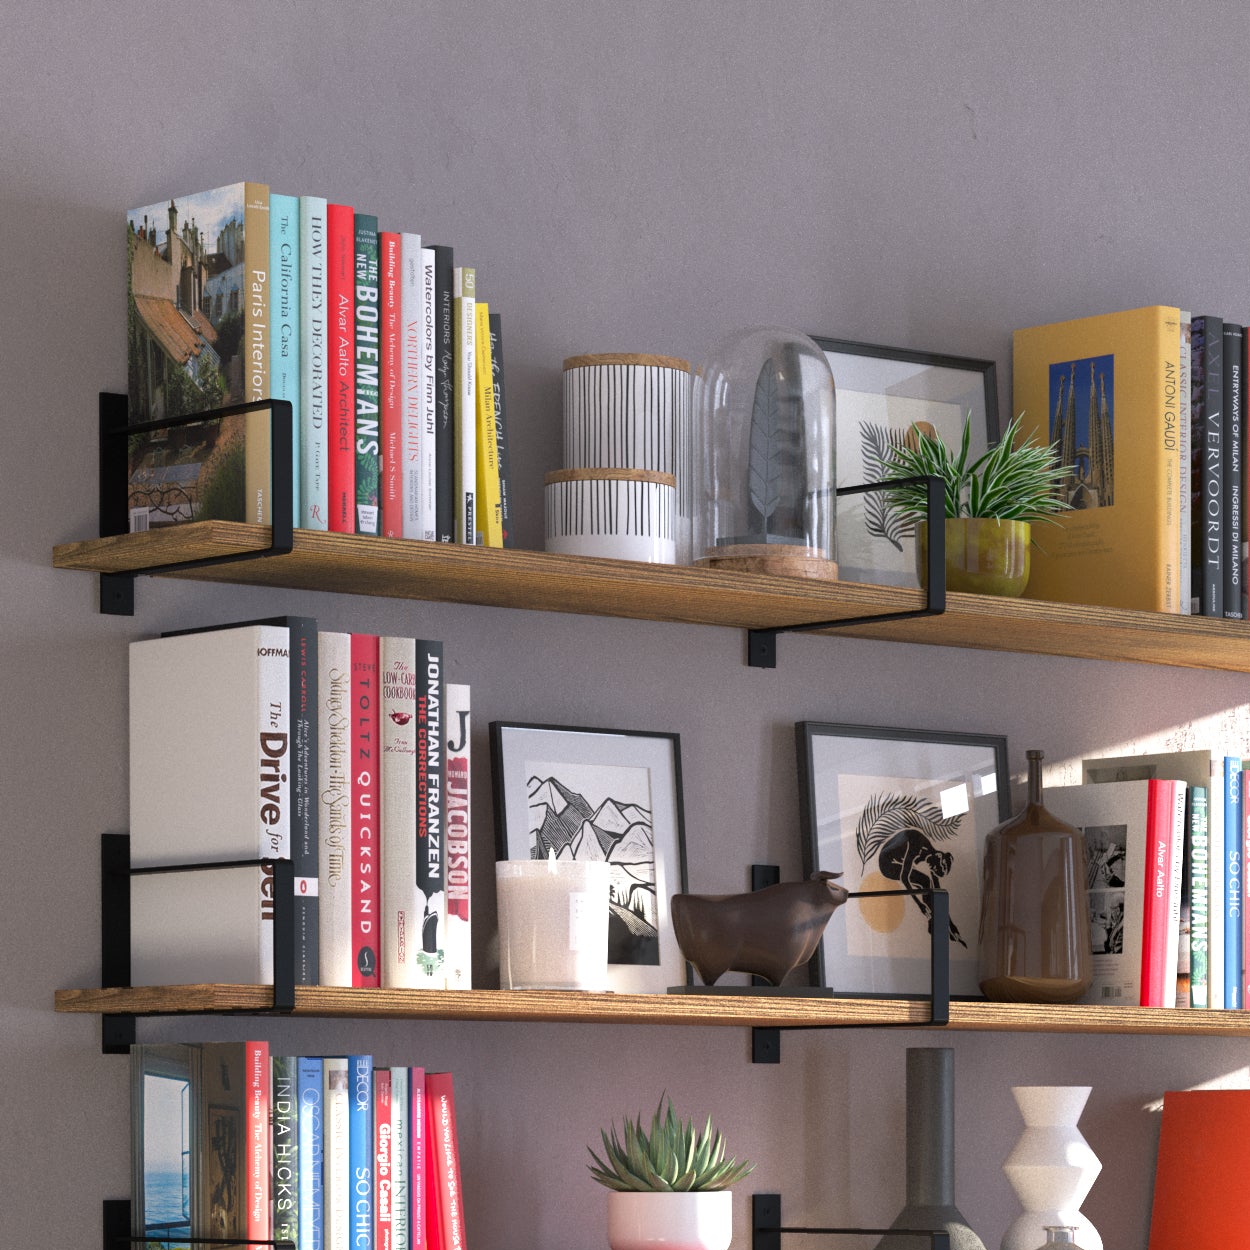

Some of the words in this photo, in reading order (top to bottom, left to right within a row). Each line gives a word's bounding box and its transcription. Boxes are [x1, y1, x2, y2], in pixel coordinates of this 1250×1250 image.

[280, 215, 289, 235] The
[311, 216, 322, 259] HOW
[356, 253, 367, 281] NEW
[368, 259, 378, 281] THE
[387, 241, 396, 278] Building
[251, 269, 267, 318] Paris
[280, 243, 293, 318] California
[311, 262, 322, 314] THEY
[387, 280, 396, 308] Beauty
[465, 273, 474, 289] 50
[338, 293, 350, 332] Alvar
[388, 313, 396, 329] The
[424, 264, 433, 351] Watercolors
[443, 290, 451, 345] INTERIORS
[280, 323, 292, 358] Casa
[338, 336, 350, 376] Aalto
[387, 333, 396, 367] Alchemy
[406, 319, 418, 392] NORTHERN
[311, 318, 323, 430] DECORATED
[356, 284, 379, 456] BOHEMIANS
[388, 369, 396, 378] of
[424, 354, 434, 371] by
[1208, 332, 1220, 399] AXEL
[387, 380, 396, 409] Design
[426, 375, 434, 404] Finn
[483, 386, 493, 412] Milan
[1164, 361, 1176, 408] ANTONI
[338, 380, 350, 452] Architect
[406, 396, 419, 462] DELIGHTS
[426, 406, 434, 434] Juhl
[1164, 411, 1179, 452] GAUDÍ
[1232, 424, 1239, 438] OF
[388, 432, 397, 464] Michael
[485, 413, 495, 470] Architecture
[256, 488, 264, 523] TASCHEN
[389, 475, 397, 500] Smith
[1207, 411, 1220, 570] VERVOORDT
[1232, 532, 1239, 542] DI
[257, 647, 289, 658] OFFMA
[353, 662, 377, 673] STEVE
[394, 661, 409, 671] The
[326, 668, 350, 713] Sidney
[270, 701, 282, 728] The
[359, 678, 371, 760] TOLTZ
[418, 694, 427, 724] THE
[427, 653, 440, 767] JONATHAN
[328, 713, 350, 769] Sheldon
[447, 711, 470, 753] J
[259, 732, 288, 826] Drive
[303, 786, 309, 794] in
[418, 728, 427, 838] CORRECTIONS
[321, 789, 350, 834] Sands
[428, 773, 440, 879] FRANZEN
[1191, 813, 1200, 832] NEW
[265, 829, 283, 852] for
[325, 836, 343, 850] of
[357, 771, 371, 934] QUICKSAND
[447, 781, 468, 900] JACOBSON
[1157, 841, 1166, 867] Alvar
[328, 850, 344, 888] Time
[1229, 850, 1240, 875] SO
[1156, 869, 1165, 898] Aalto
[1229, 877, 1240, 918] CHIC
[253, 1050, 262, 1088] Building
[252, 1090, 262, 1120] Beauty
[277, 1077, 291, 1136] INDIA
[302, 1087, 320, 1156] OSCAR
[440, 1095, 449, 1126] WOULD
[254, 1123, 262, 1141] The
[377, 1123, 391, 1176] Giorgio
[396, 1119, 404, 1177] mexican
[252, 1143, 262, 1179] Alchemy
[277, 1144, 292, 1210] HICKS
[447, 1168, 454, 1180] TO
[254, 1181, 262, 1191] of
[355, 1167, 370, 1195] SO
[252, 1192, 262, 1222] Design
[355, 1199, 370, 1247] CHIC
[450, 1199, 459, 1217] THE
